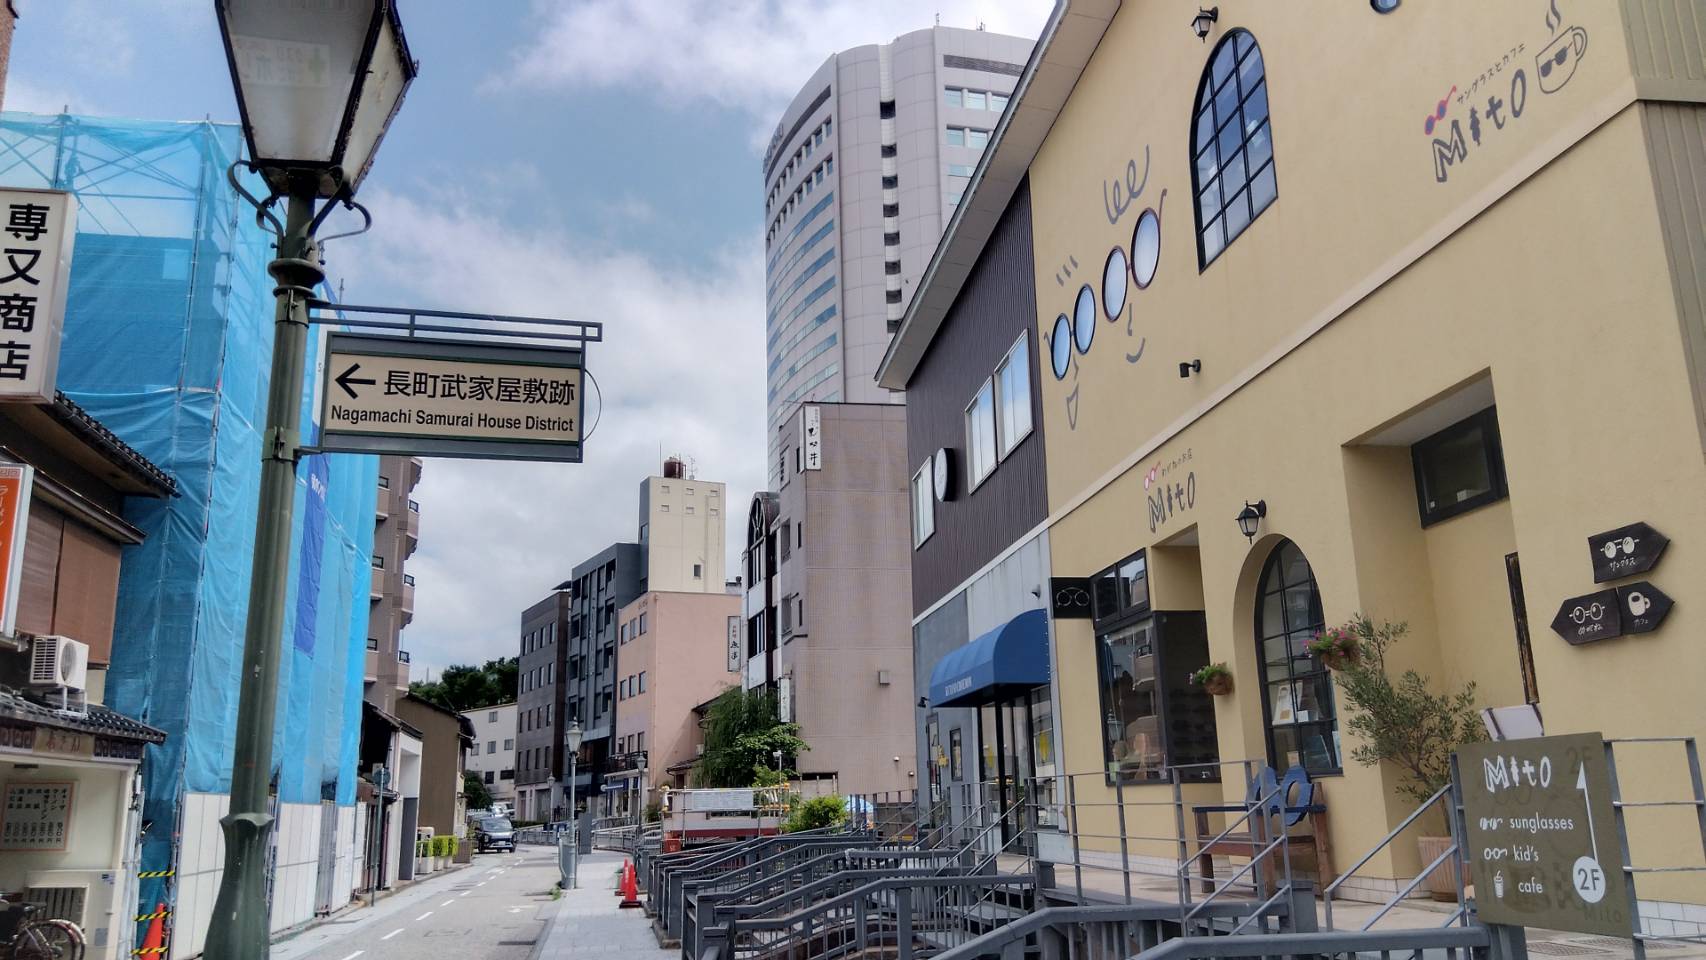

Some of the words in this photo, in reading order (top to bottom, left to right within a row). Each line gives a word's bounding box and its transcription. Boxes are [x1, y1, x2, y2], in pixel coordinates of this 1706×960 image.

[384, 369, 575, 406] 長町武家屋敷跡
[331, 405, 412, 425] Nagamachi
[416, 409, 474, 427] Samurai
[477, 413, 521, 429] House
[525, 415, 574, 432] District
[1509, 812, 1574, 834] sunglasses
[1513, 845, 1539, 863] kid's
[1518, 877, 1544, 894] cafe
[1577, 868, 1600, 891] 2F
